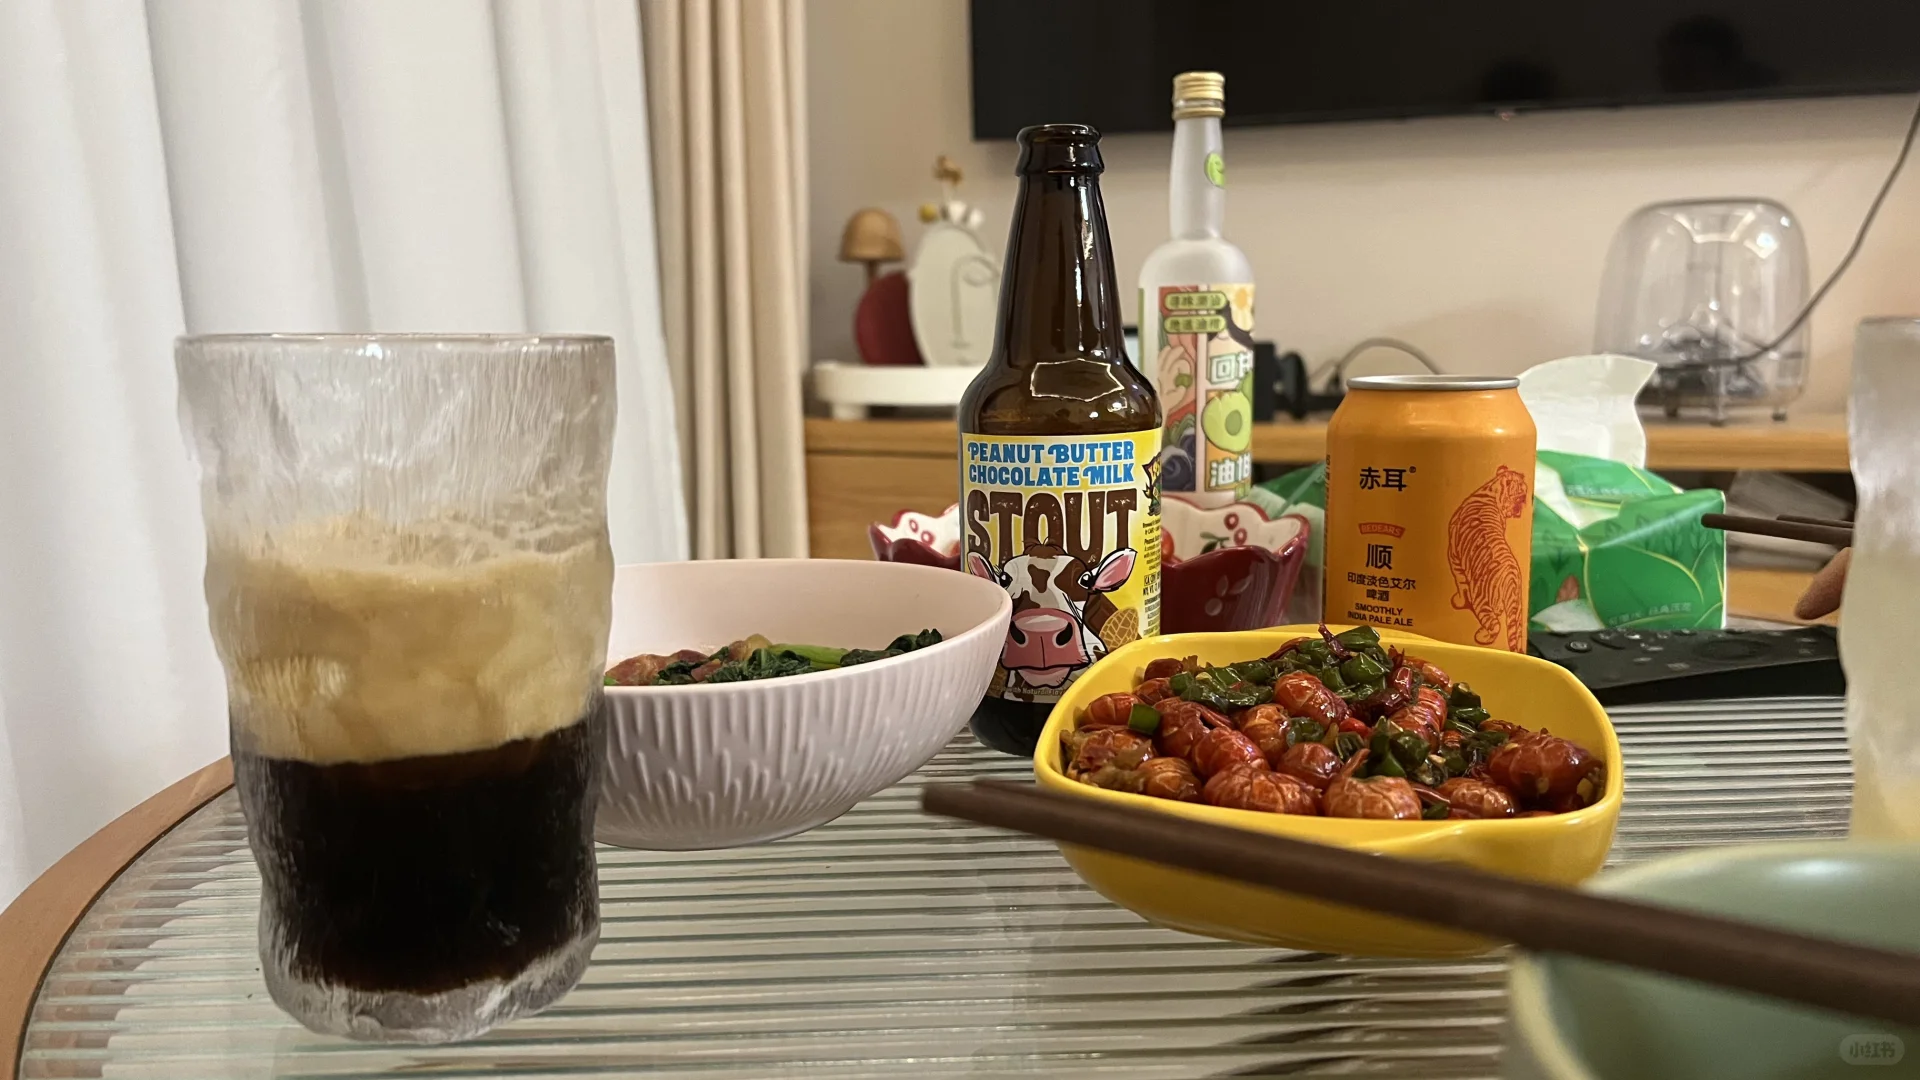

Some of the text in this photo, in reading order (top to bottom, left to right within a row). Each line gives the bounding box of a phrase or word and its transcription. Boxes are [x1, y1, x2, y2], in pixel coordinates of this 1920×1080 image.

[968, 440, 1135, 464] PEANUT BUTTER
[969, 464, 1080, 486] CHOCOLATE
[1083, 463, 1135, 484] MILK
[967, 488, 1138, 565] STOUT
[1366, 543, 1393, 570] 顺
[1347, 572, 1416, 590] 印度淡色艾尔
[1366, 589, 1390, 602] 啤酒
[1347, 611, 1414, 627] INDIA PALE ALE
[1355, 603, 1403, 616] SMOOTHLY
